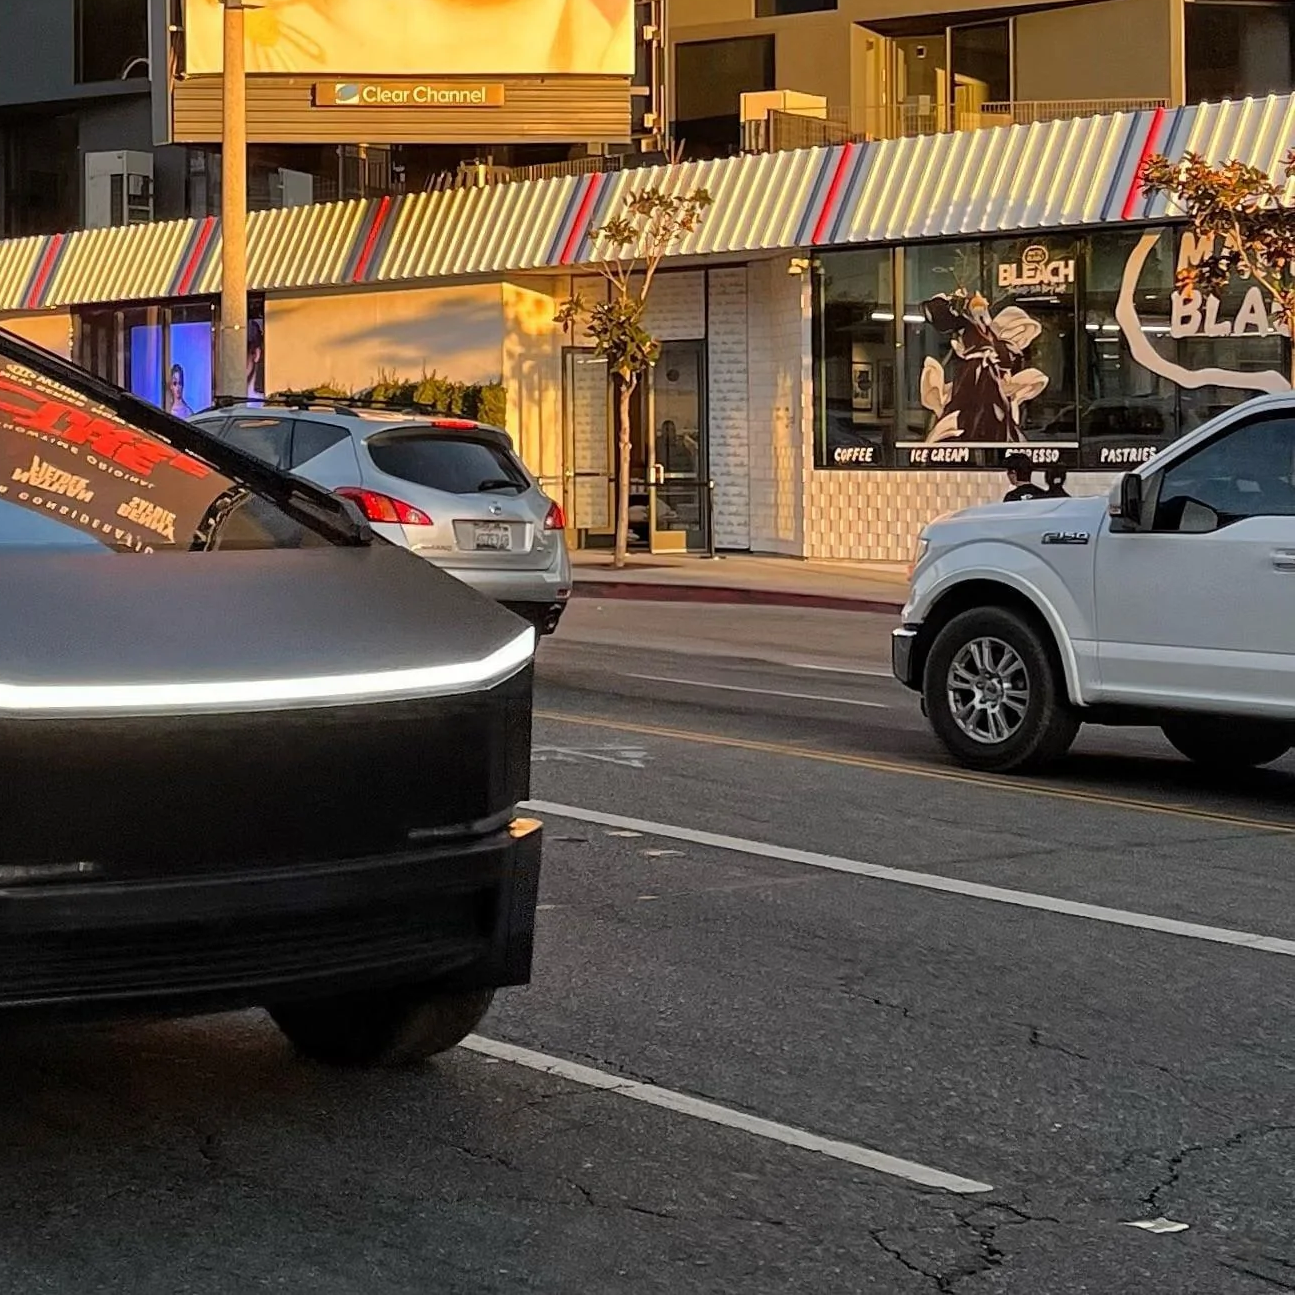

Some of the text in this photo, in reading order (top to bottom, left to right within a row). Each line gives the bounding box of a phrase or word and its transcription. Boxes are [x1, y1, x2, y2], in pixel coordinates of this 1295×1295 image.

[362, 86, 486, 103] Clear Channel
[999, 260, 1075, 286] BLEACH
[834, 447, 874, 462] COFFEE
[910, 447, 970, 463] ICE CREAM
[1100, 447, 1157, 462] PASTRIES
